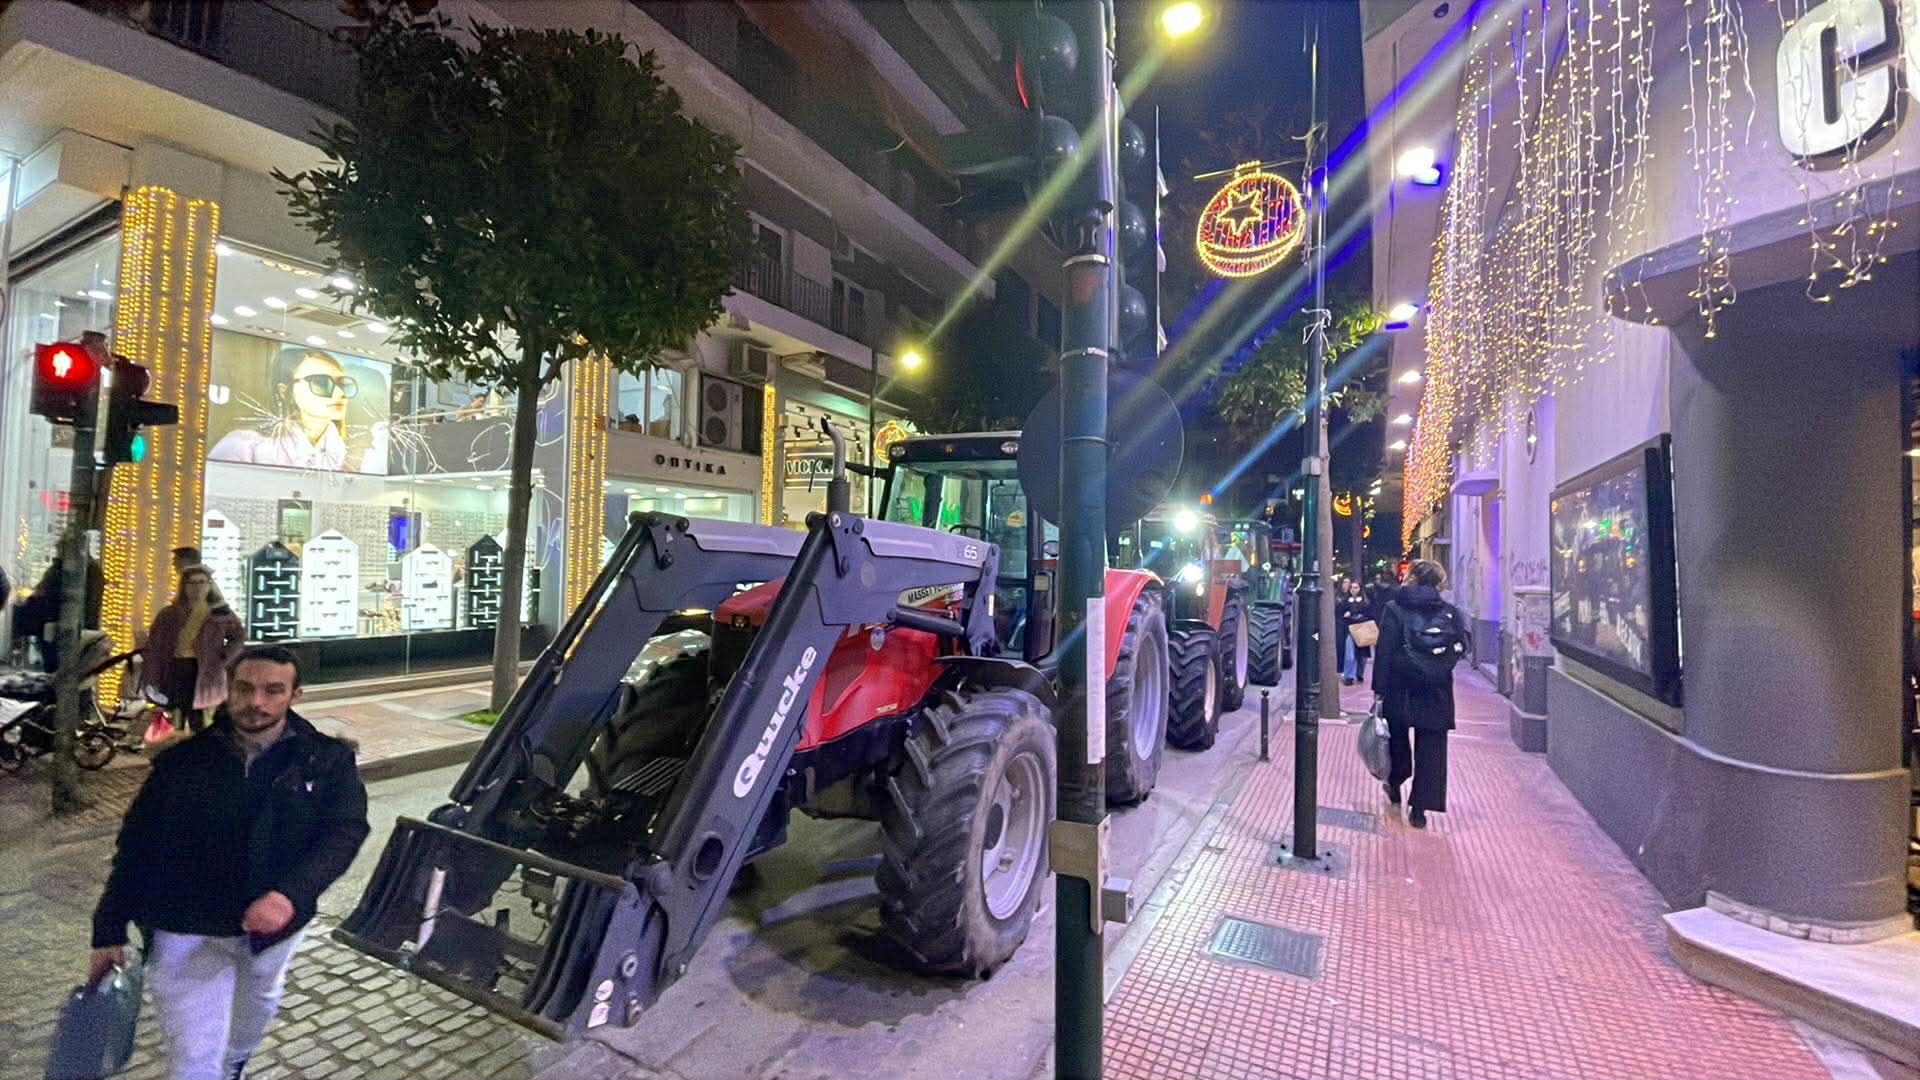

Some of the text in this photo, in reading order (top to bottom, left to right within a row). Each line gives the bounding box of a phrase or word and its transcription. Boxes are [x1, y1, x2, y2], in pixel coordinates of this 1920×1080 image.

[1777, 0, 1920, 158] C
[655, 454, 727, 475] ΟΠΤΙΚΑ
[964, 545, 978, 560] 65
[733, 646, 817, 798] Quicke
